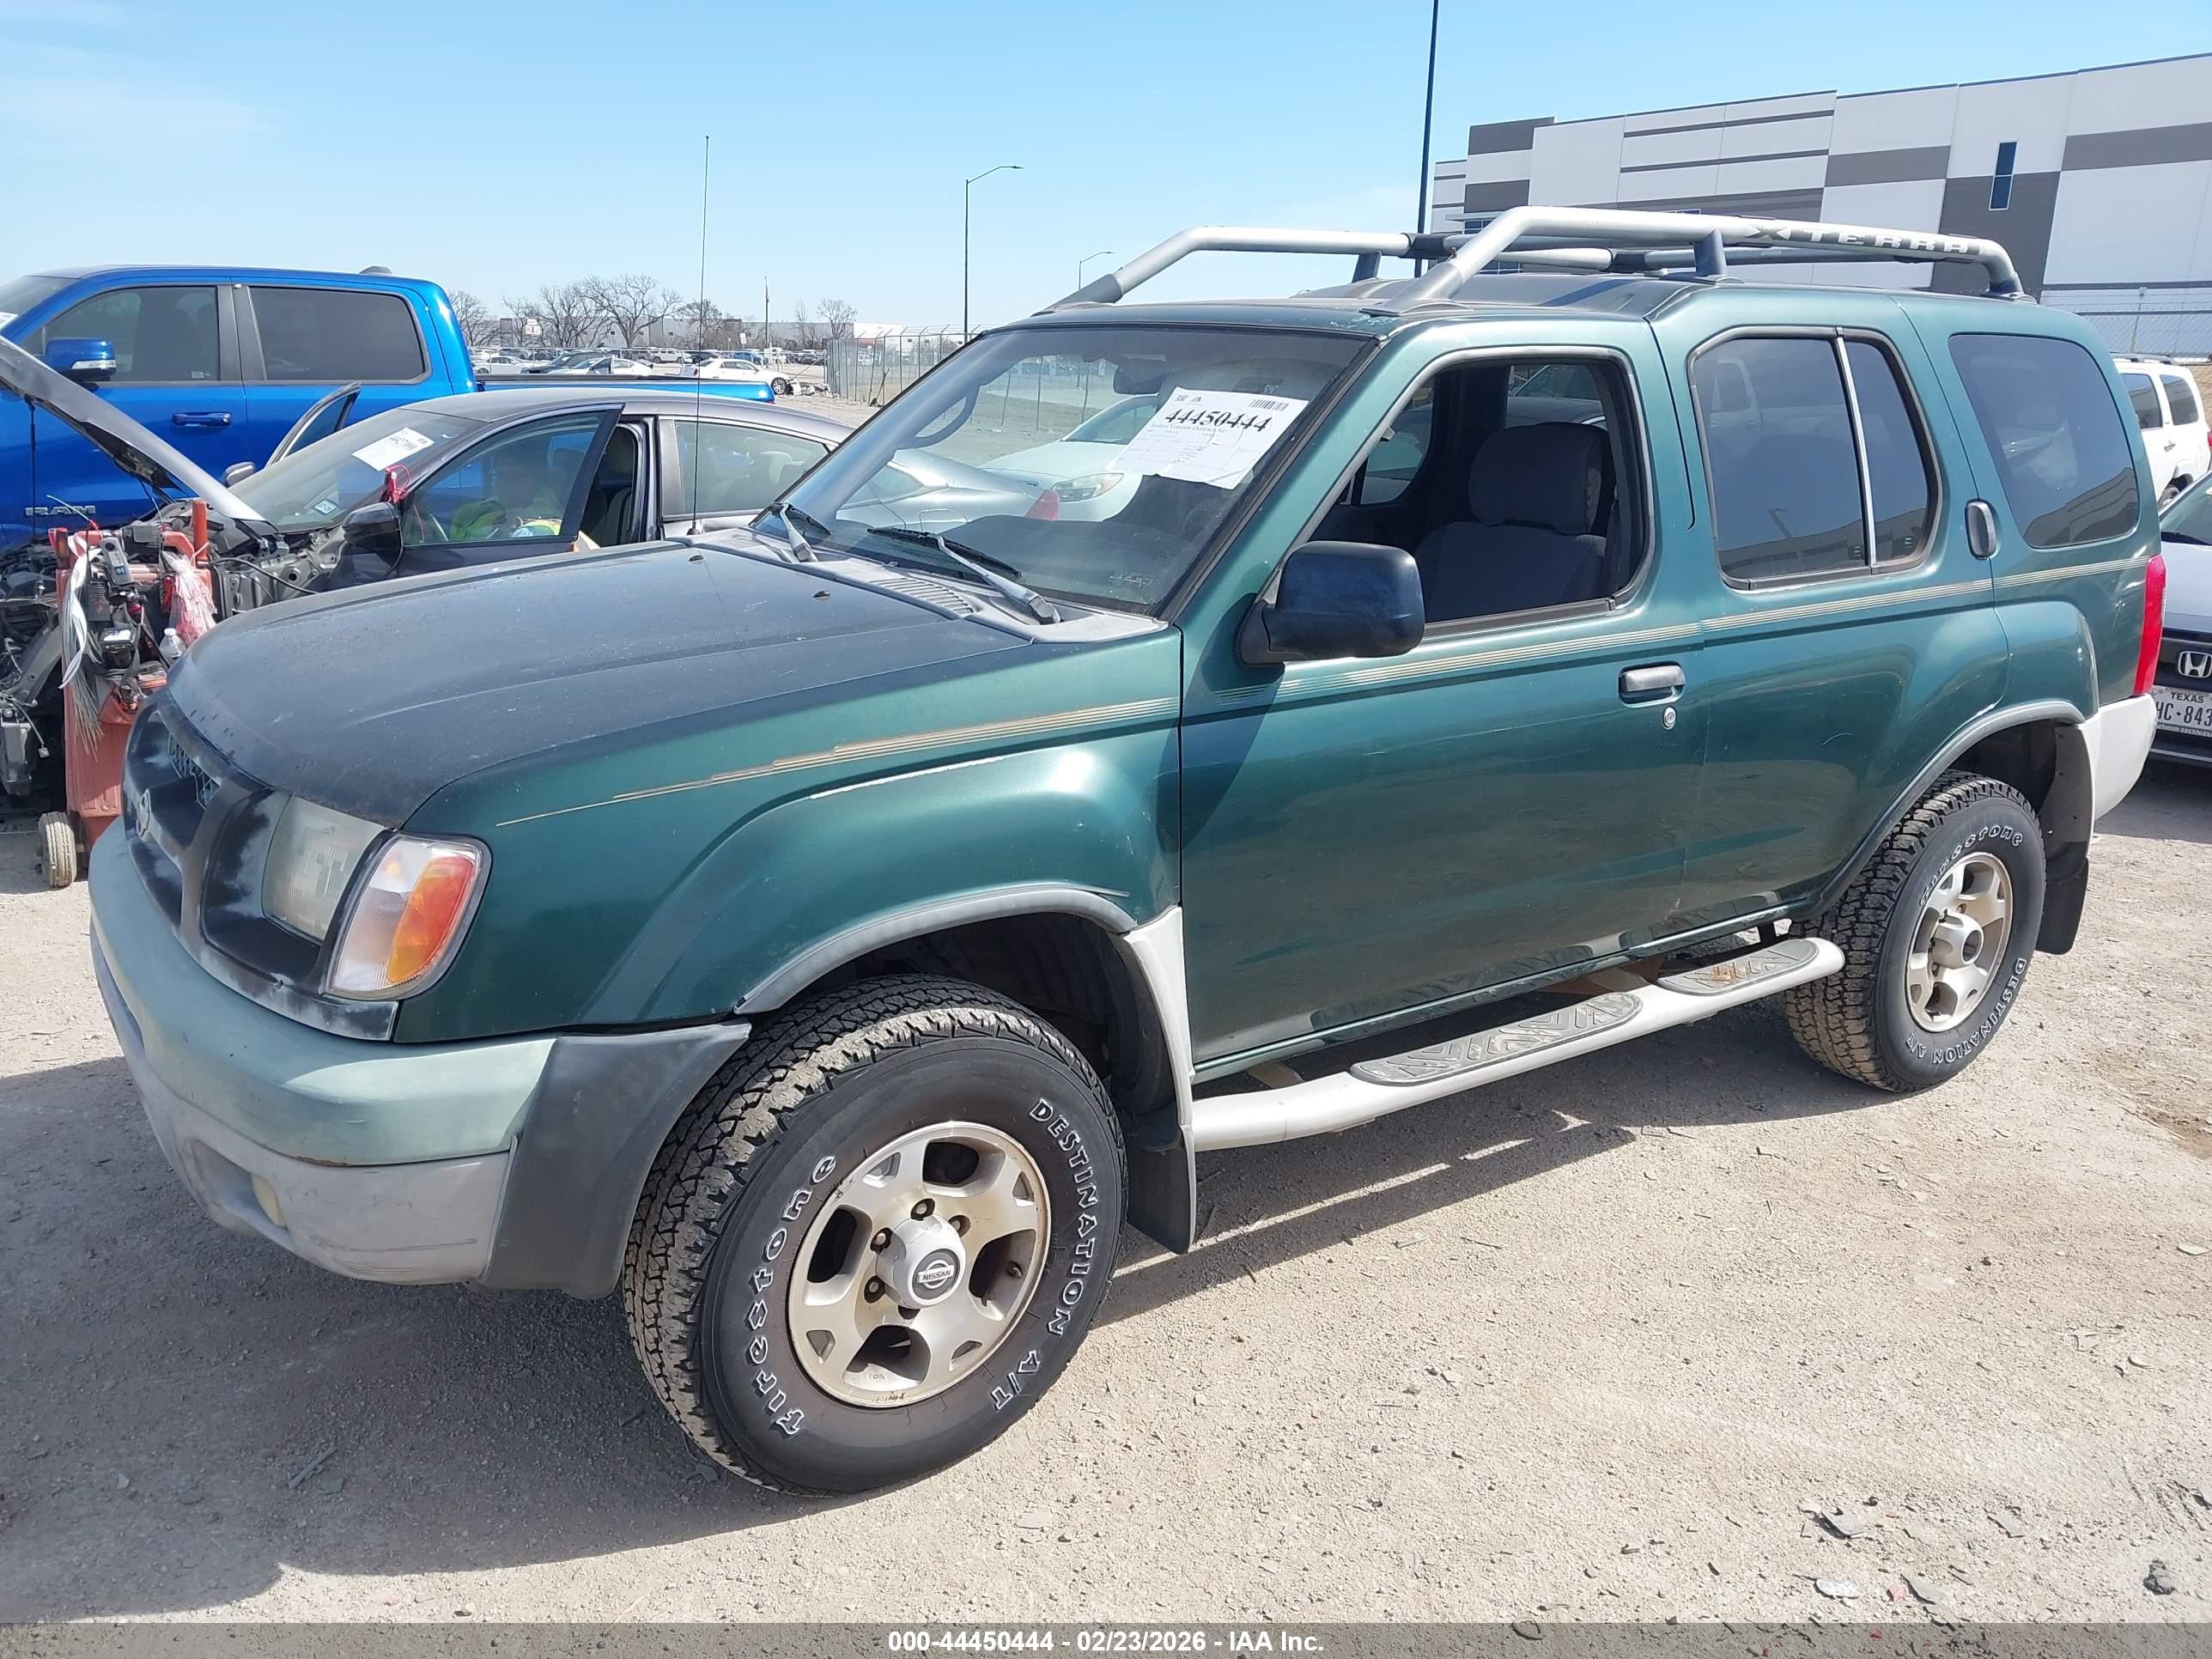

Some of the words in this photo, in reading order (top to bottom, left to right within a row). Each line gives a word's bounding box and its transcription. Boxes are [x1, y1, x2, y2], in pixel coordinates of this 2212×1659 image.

[1747, 224, 1977, 255] XTERRA
[1165, 409, 1273, 431] 44450444
[25, 505, 95, 515] RAM
[2171, 692, 2204, 703] TEXAS
[1918, 824, 2024, 908] Firestone
[1932, 958, 2027, 1066] DESTINATION
[1028, 1098, 1100, 1338] DESTINATION
[746, 1153, 838, 1436] Firestone
[922, 1270, 951, 1280] NISSAN
[991, 1349, 1042, 1411] A/T
